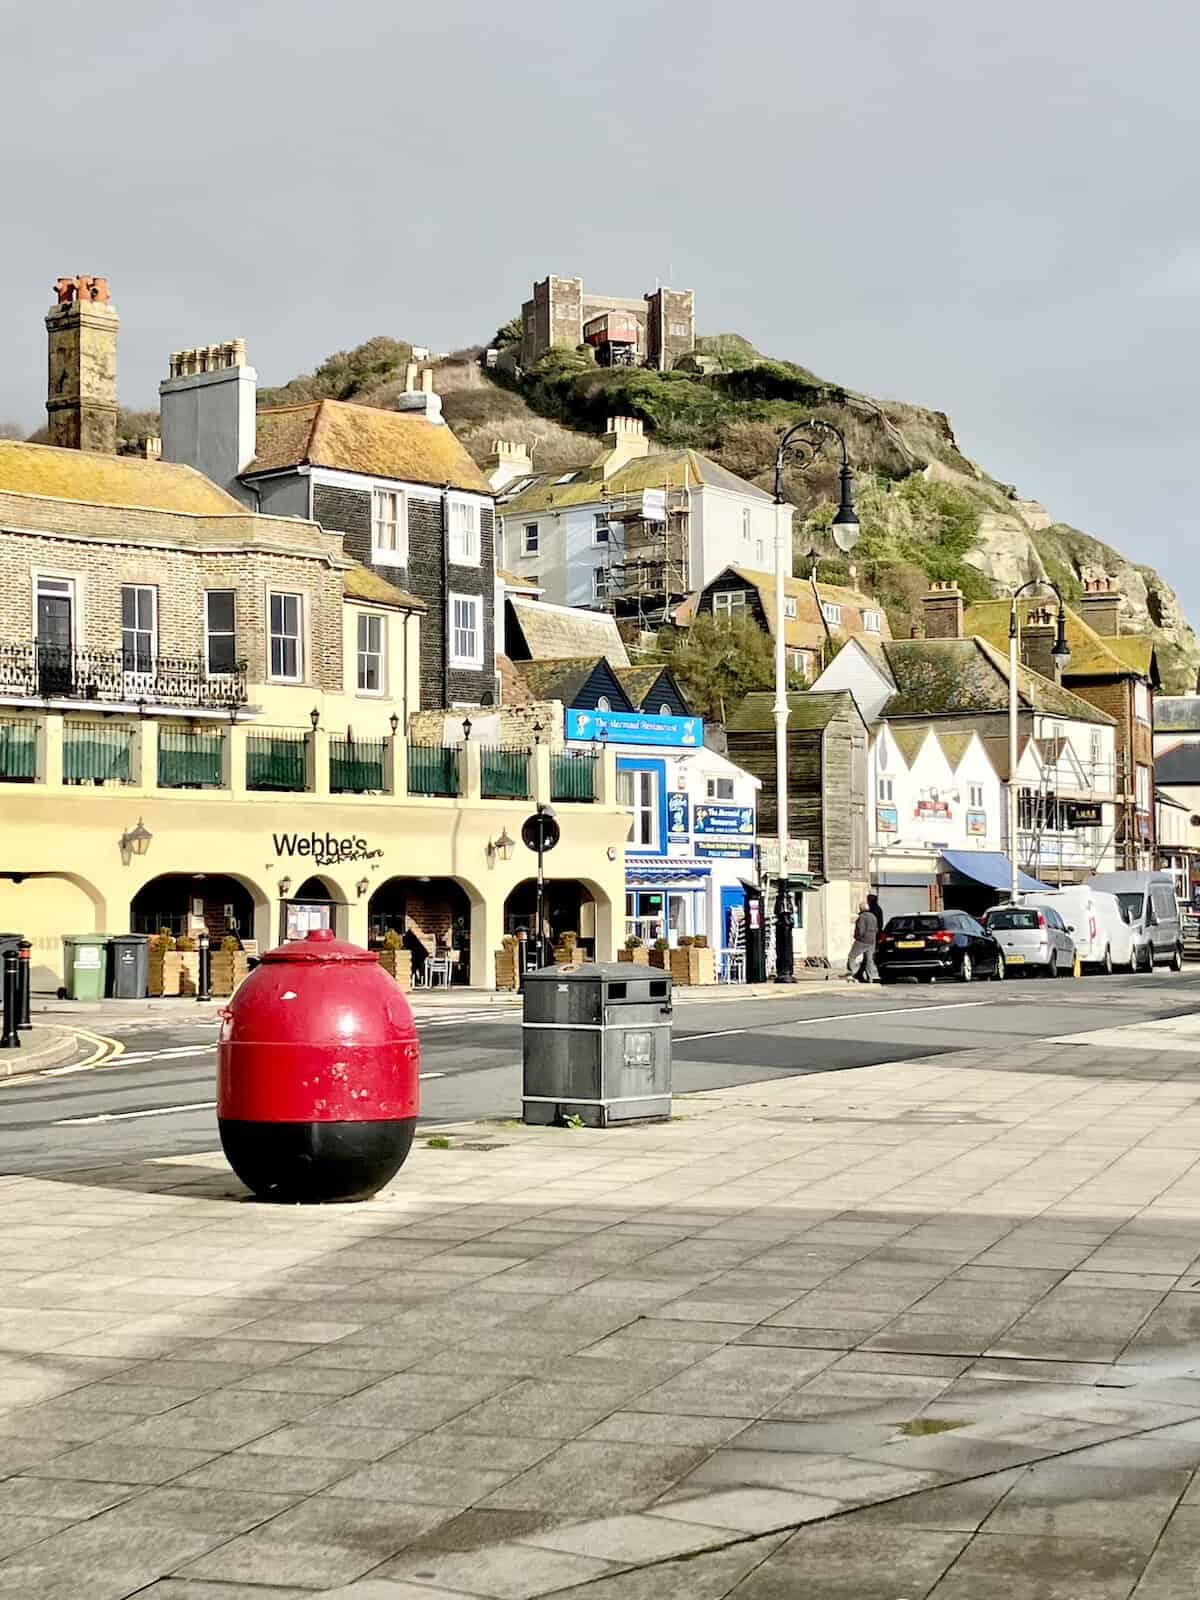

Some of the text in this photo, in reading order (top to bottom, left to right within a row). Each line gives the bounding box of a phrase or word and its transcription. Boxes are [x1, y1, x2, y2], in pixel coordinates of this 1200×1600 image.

[595, 717, 607, 728] The
[610, 719, 640, 729] Mermaid
[272, 832, 367, 856] Webbe's
